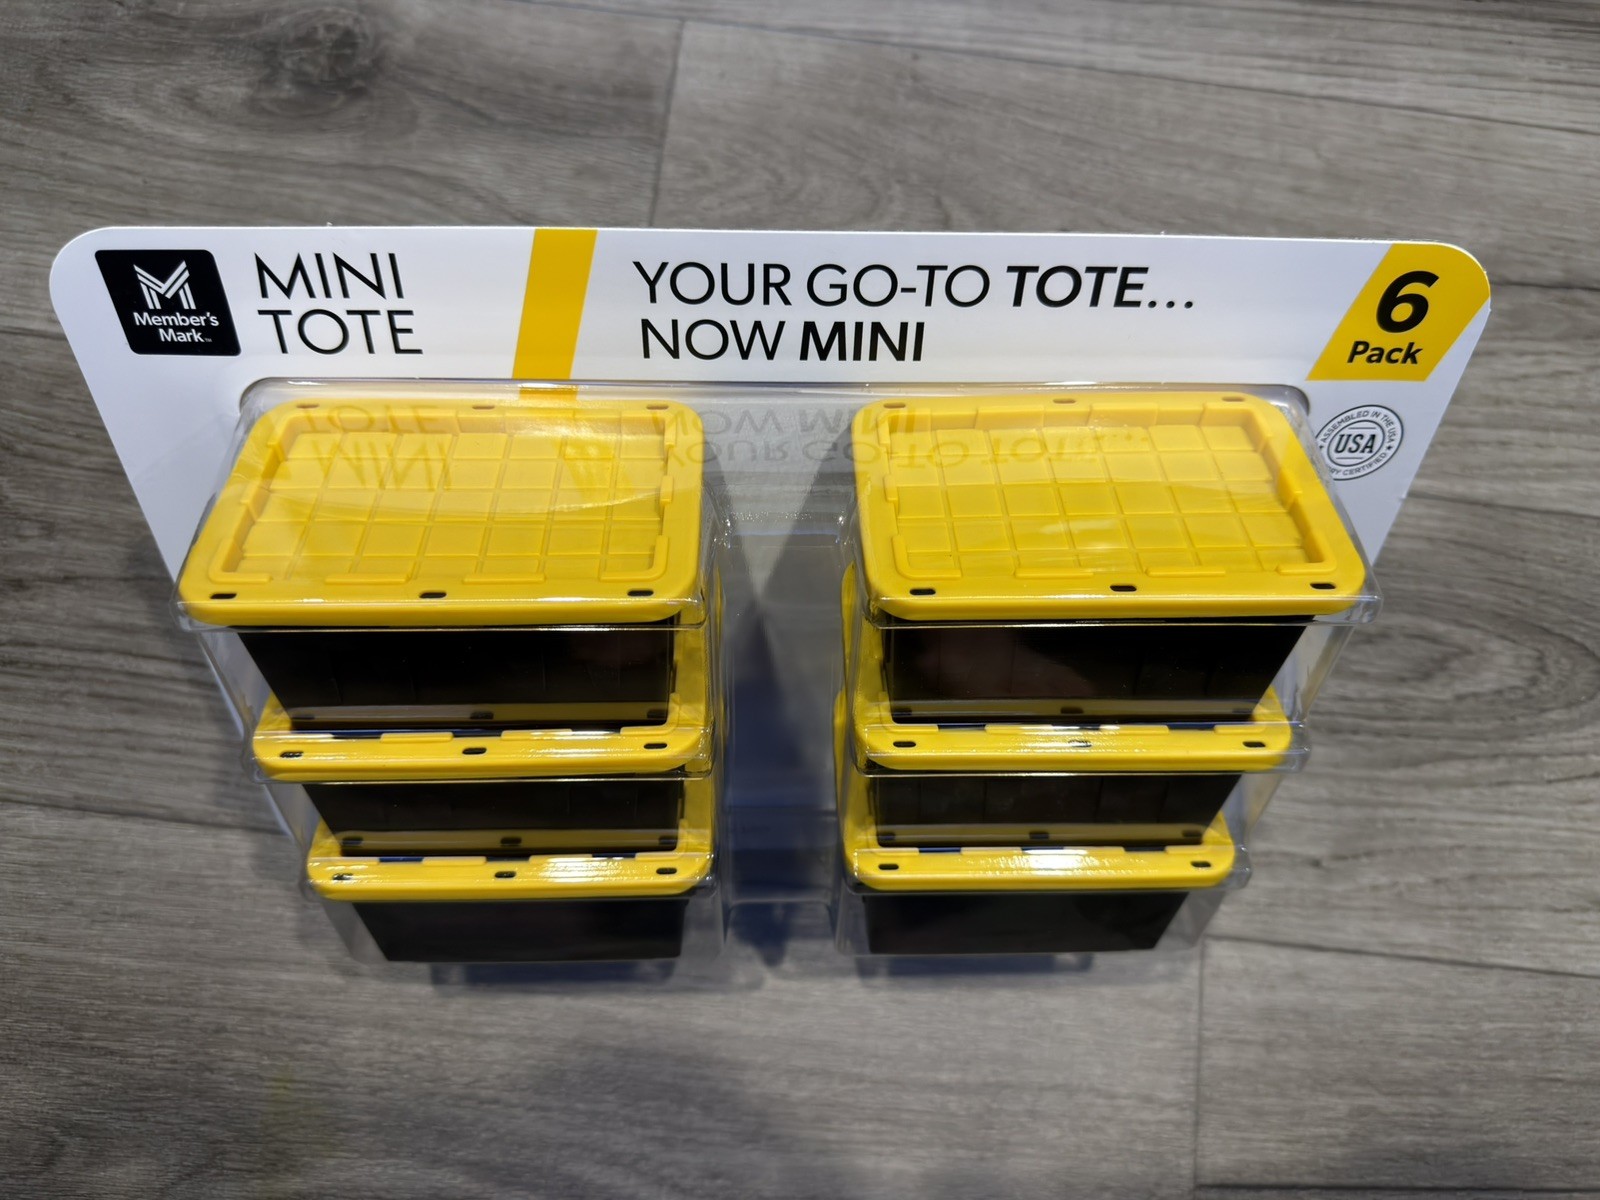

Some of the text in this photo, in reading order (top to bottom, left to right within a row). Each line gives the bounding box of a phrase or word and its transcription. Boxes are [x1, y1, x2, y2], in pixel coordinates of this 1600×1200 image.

[254, 252, 405, 300] MINI
[632, 261, 1194, 309] YOUR GO-TO TOTE...
[133, 311, 219, 327] Member's
[1376, 270, 1440, 334] 6
[257, 309, 423, 355] TOTE
[641, 318, 925, 362] NOW MINI
[1347, 340, 1423, 365] Pack
[1321, 410, 1369, 443] ASSEMBLED
[1380, 415, 1394, 428] THE
[1388, 427, 1397, 443] USA
[1333, 433, 1377, 454] USA
[1342, 452, 1387, 476] CERTIFIED
